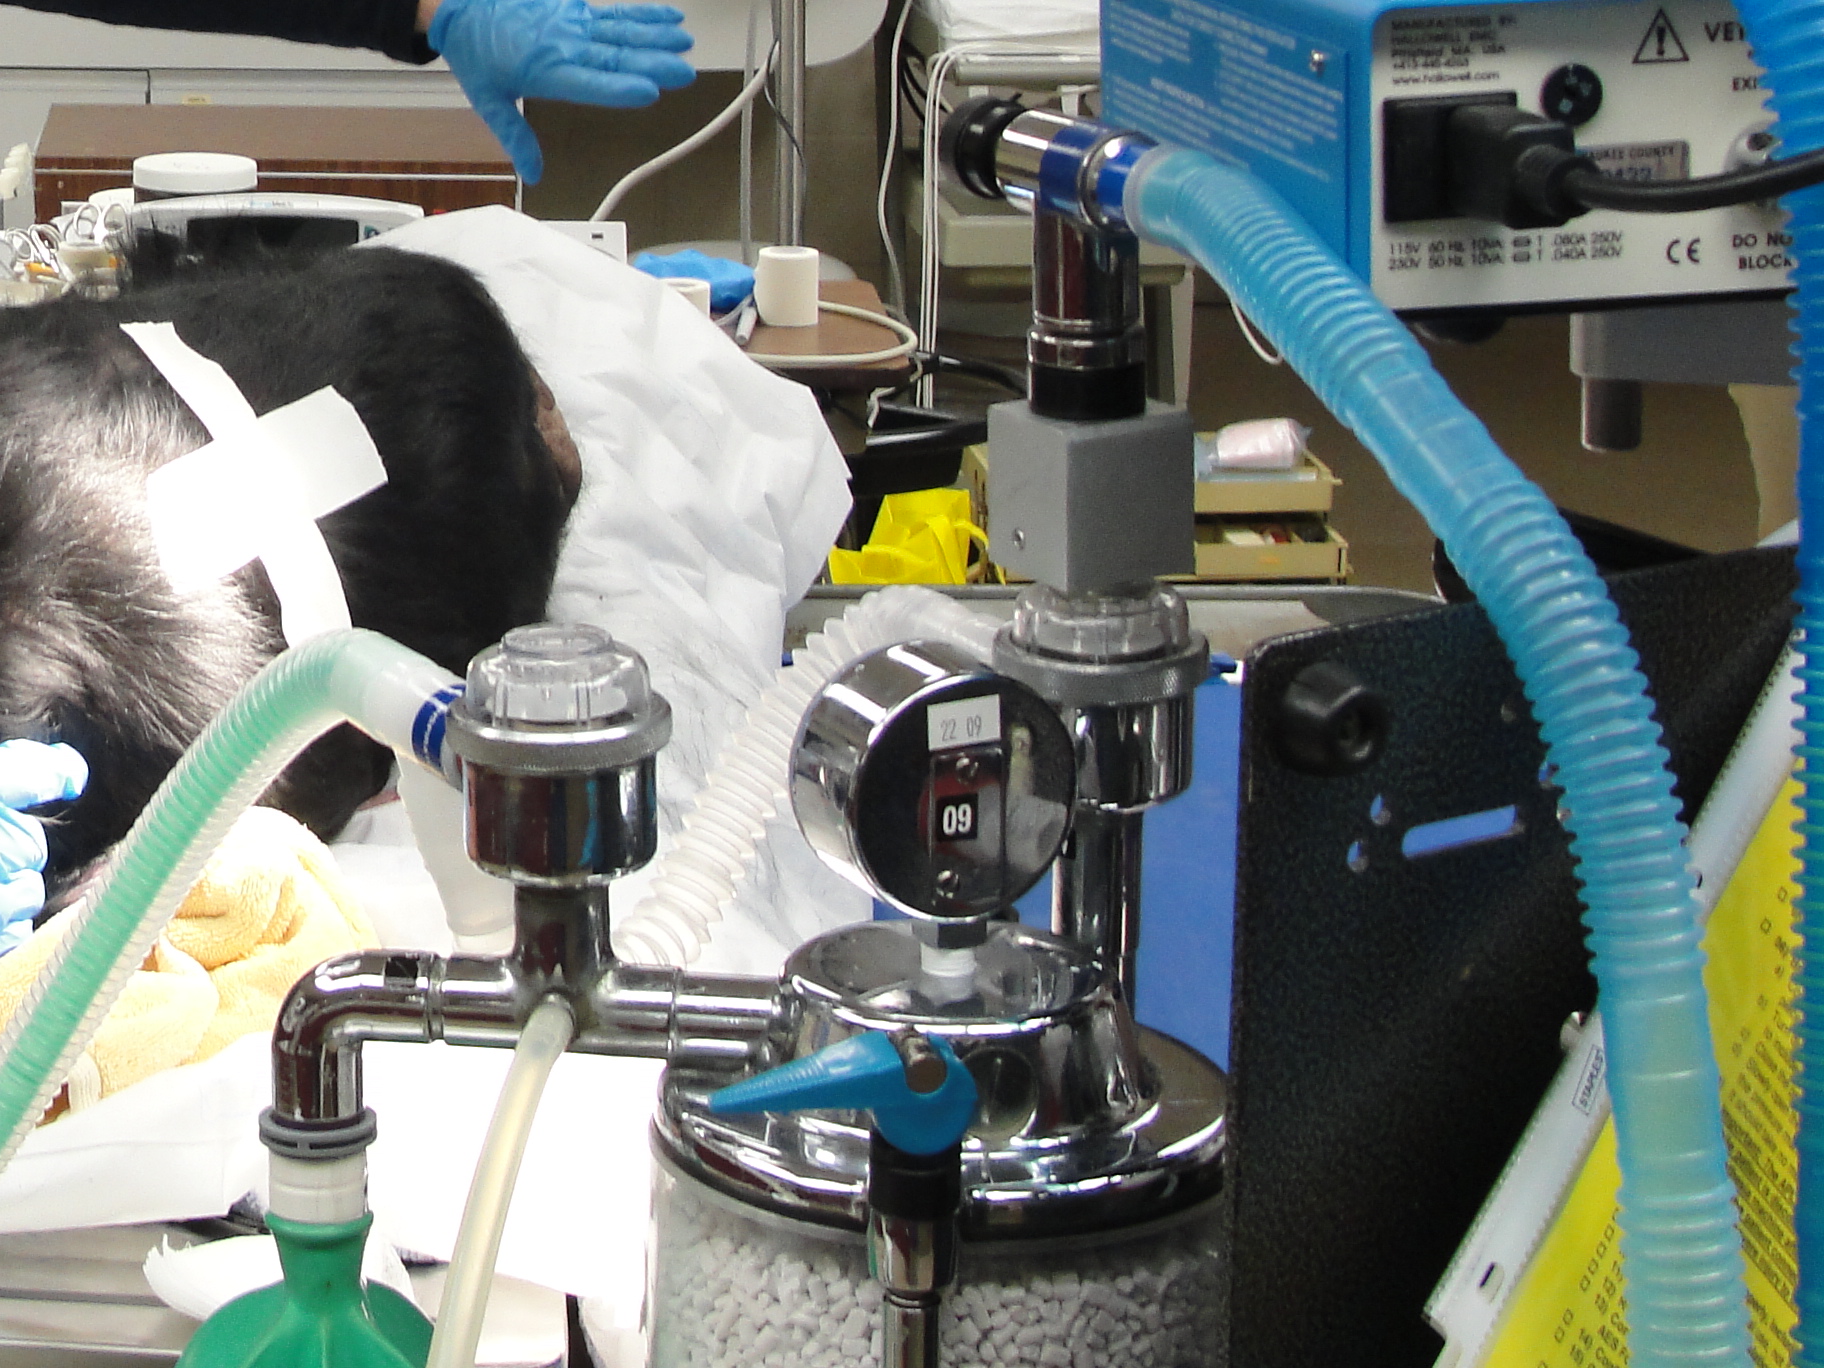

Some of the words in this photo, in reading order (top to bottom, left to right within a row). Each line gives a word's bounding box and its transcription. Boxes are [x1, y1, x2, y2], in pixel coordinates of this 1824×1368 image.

[1732, 233, 1757, 248] DO
[1767, 231, 1793, 248] NO
[1738, 252, 1793, 271] BLOCK
[940, 718, 957, 743] 22
[942, 802, 972, 836] 09
